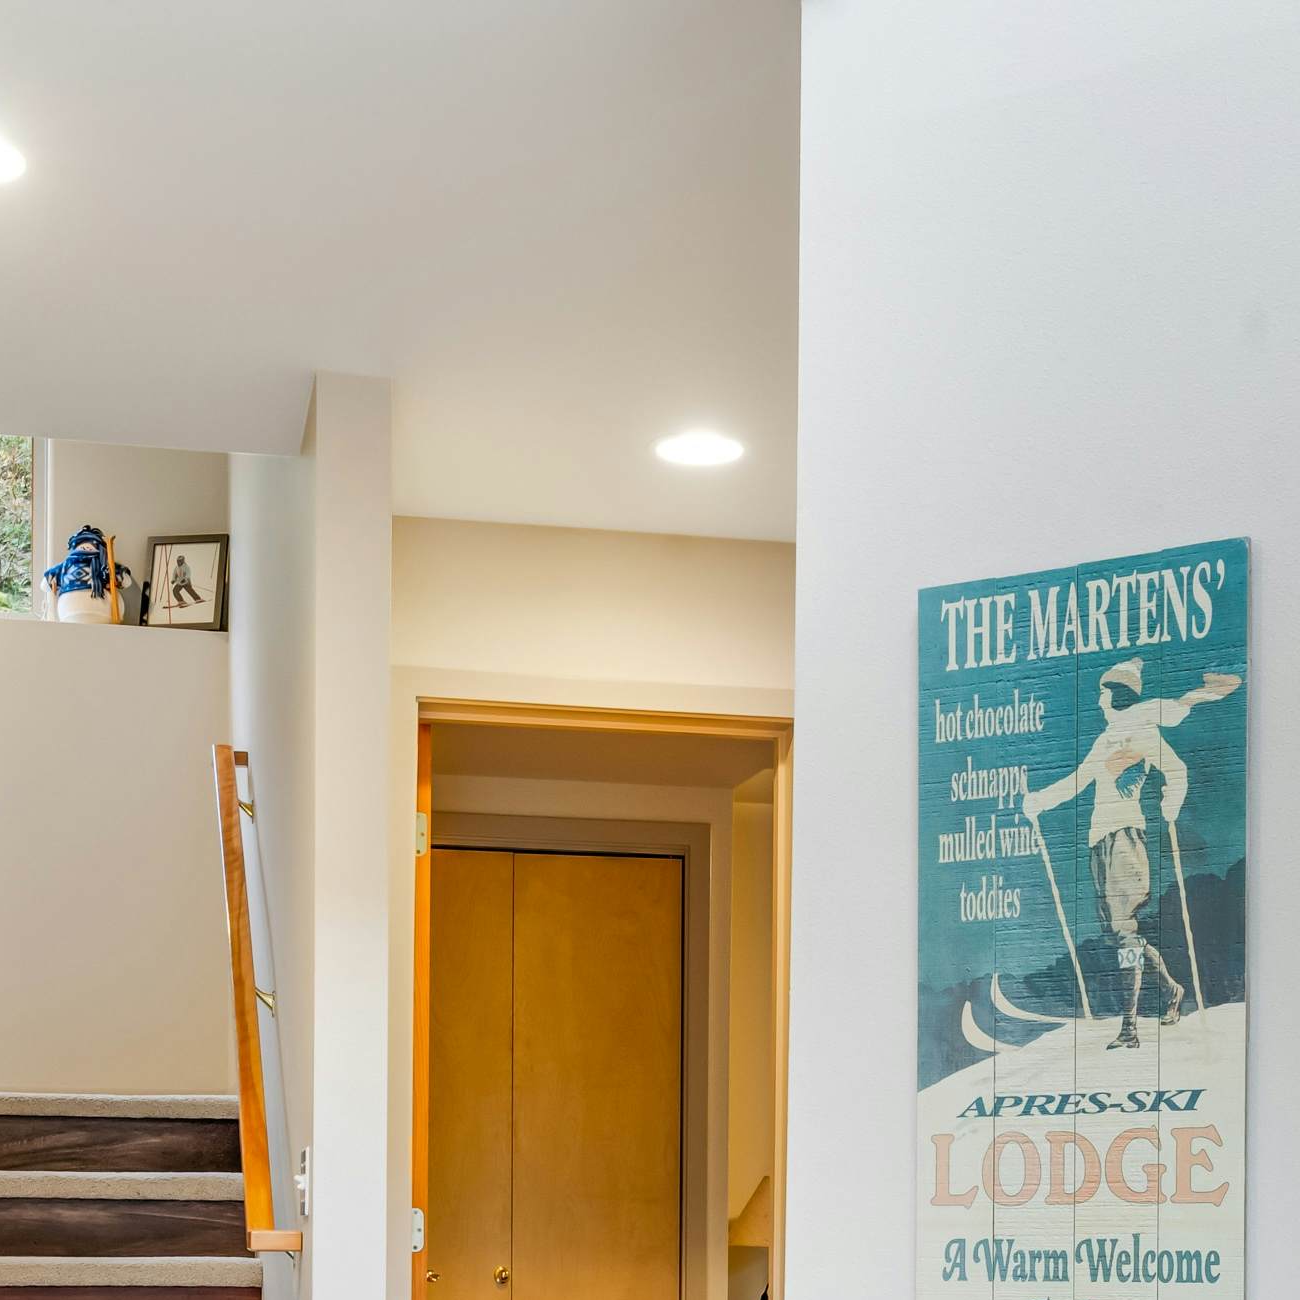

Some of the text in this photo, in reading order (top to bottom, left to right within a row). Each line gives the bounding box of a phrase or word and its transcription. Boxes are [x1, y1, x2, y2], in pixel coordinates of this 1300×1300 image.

[940, 593, 1018, 672] THE
[934, 688, 1045, 744] hot chocolate
[938, 813, 1042, 864] mulled wine
[960, 876, 1021, 922] toddies
[957, 1088, 1207, 1119] APRES-SKI
[930, 1124, 1230, 1210] LODGE
[942, 1232, 1221, 1284] A Warm Welcome
